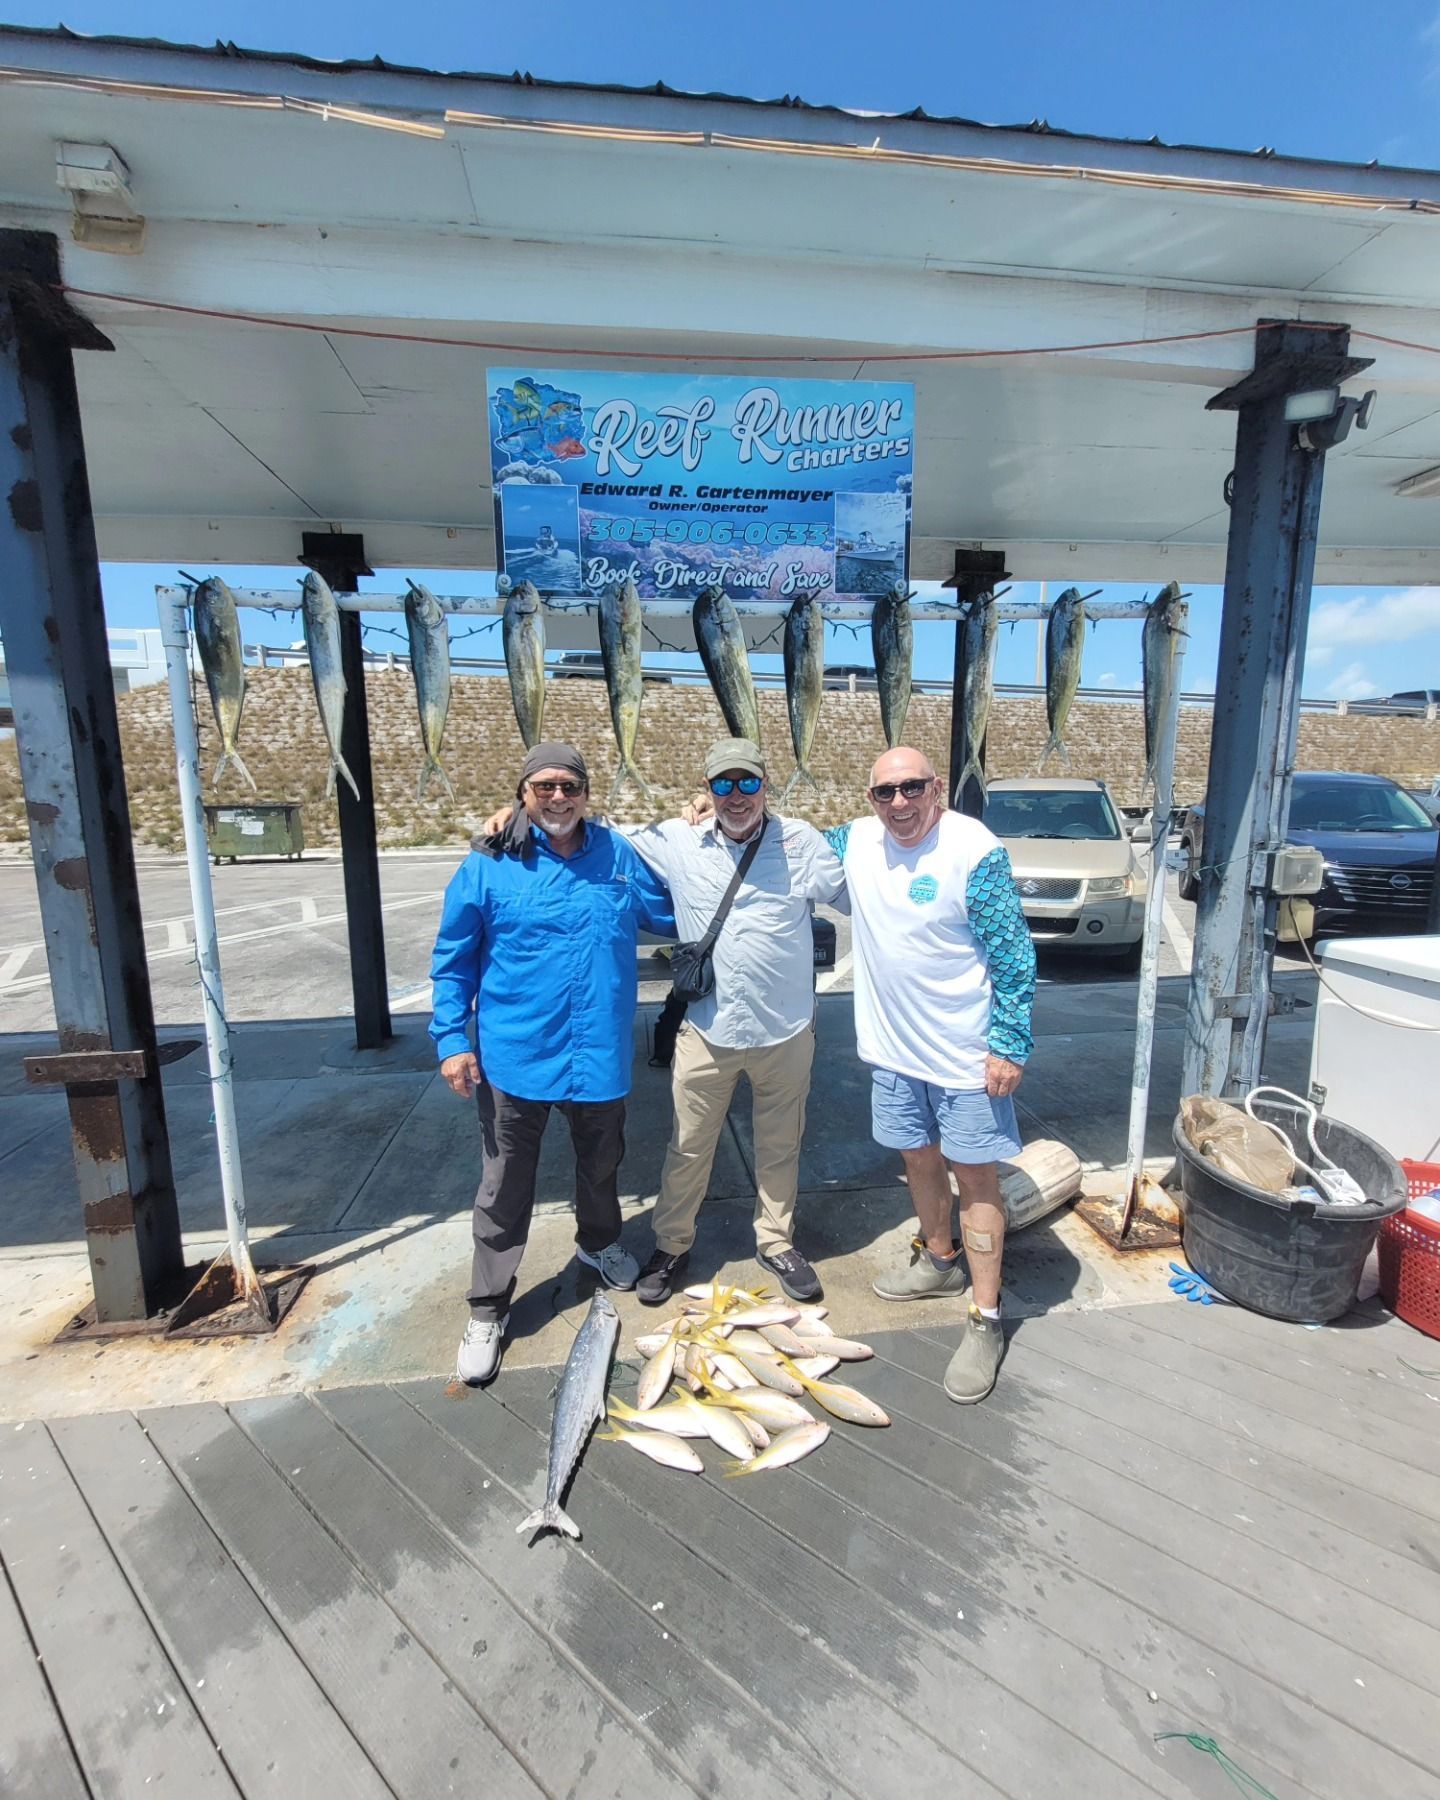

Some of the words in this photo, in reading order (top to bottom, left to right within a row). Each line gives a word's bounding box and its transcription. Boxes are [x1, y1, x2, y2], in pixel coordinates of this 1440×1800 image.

[588, 395, 715, 478] Reef
[730, 386, 903, 464] Runner
[580, 482, 663, 497] Edward
[668, 485, 688, 498] R.
[696, 485, 833, 502] Gartenmayer
[648, 501, 768, 513] Owner/Operator
[588, 517, 830, 546] 305-906-0633
[585, 556, 641, 588] Book
[653, 559, 735, 590] Direct
[732, 562, 778, 589] and
[780, 561, 833, 596] Save
